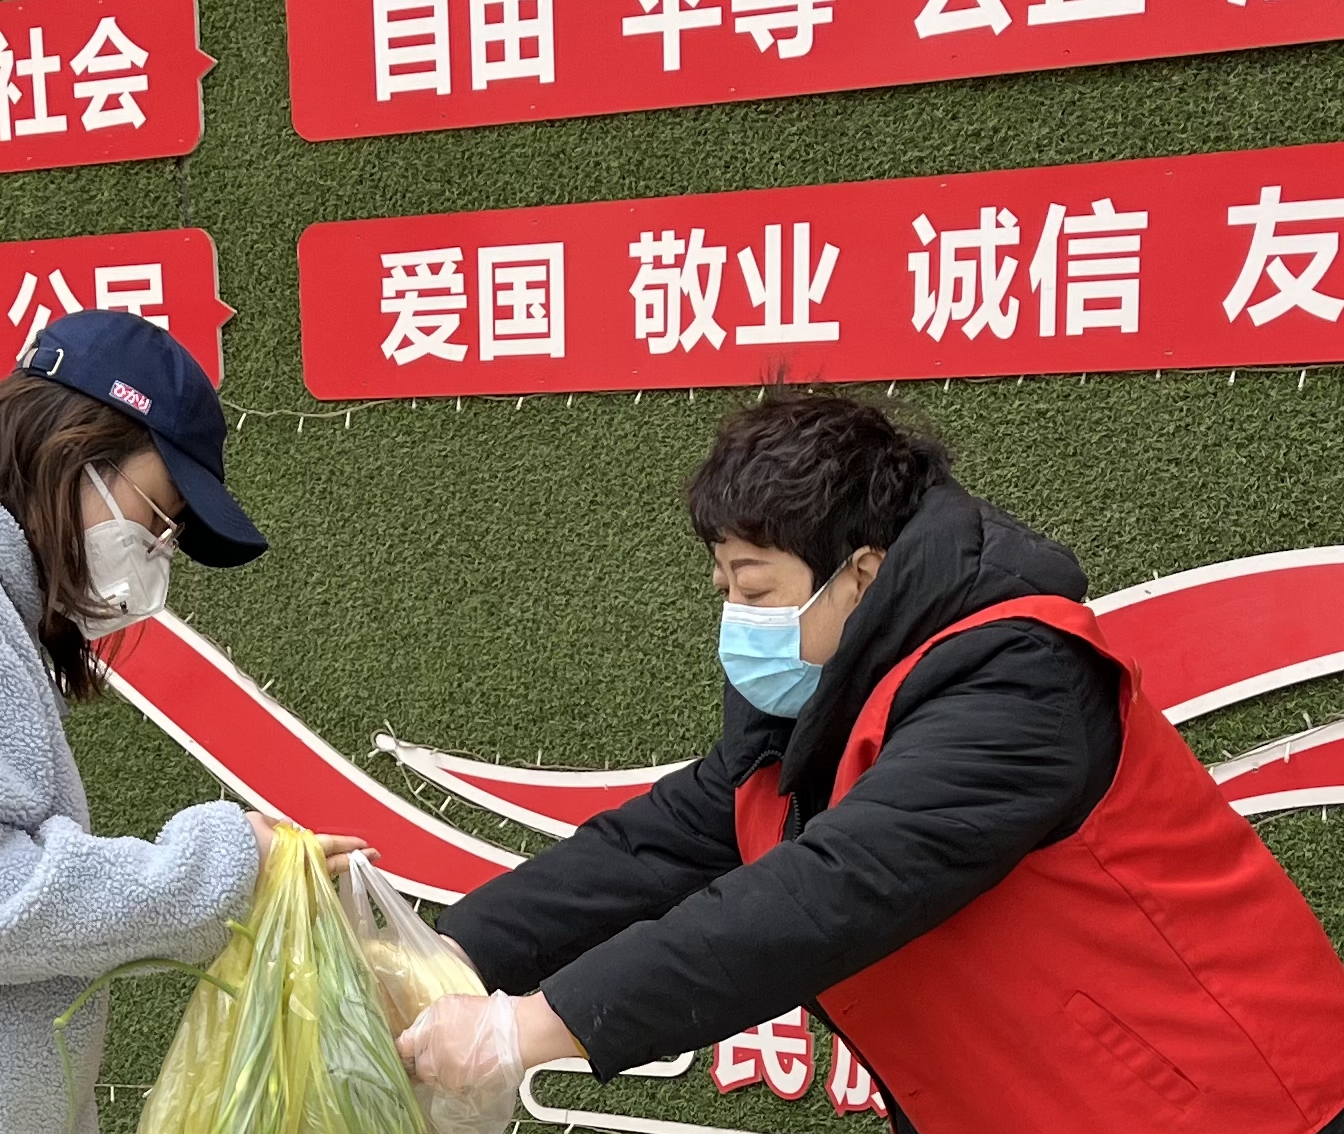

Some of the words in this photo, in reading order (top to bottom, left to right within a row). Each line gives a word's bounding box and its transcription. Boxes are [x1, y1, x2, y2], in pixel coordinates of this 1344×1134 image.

[373, 0, 555, 101] 自由
[380, 242, 565, 366] 爱国
[629, 222, 840, 354] 敬业
[907, 198, 1148, 342] 诚信
